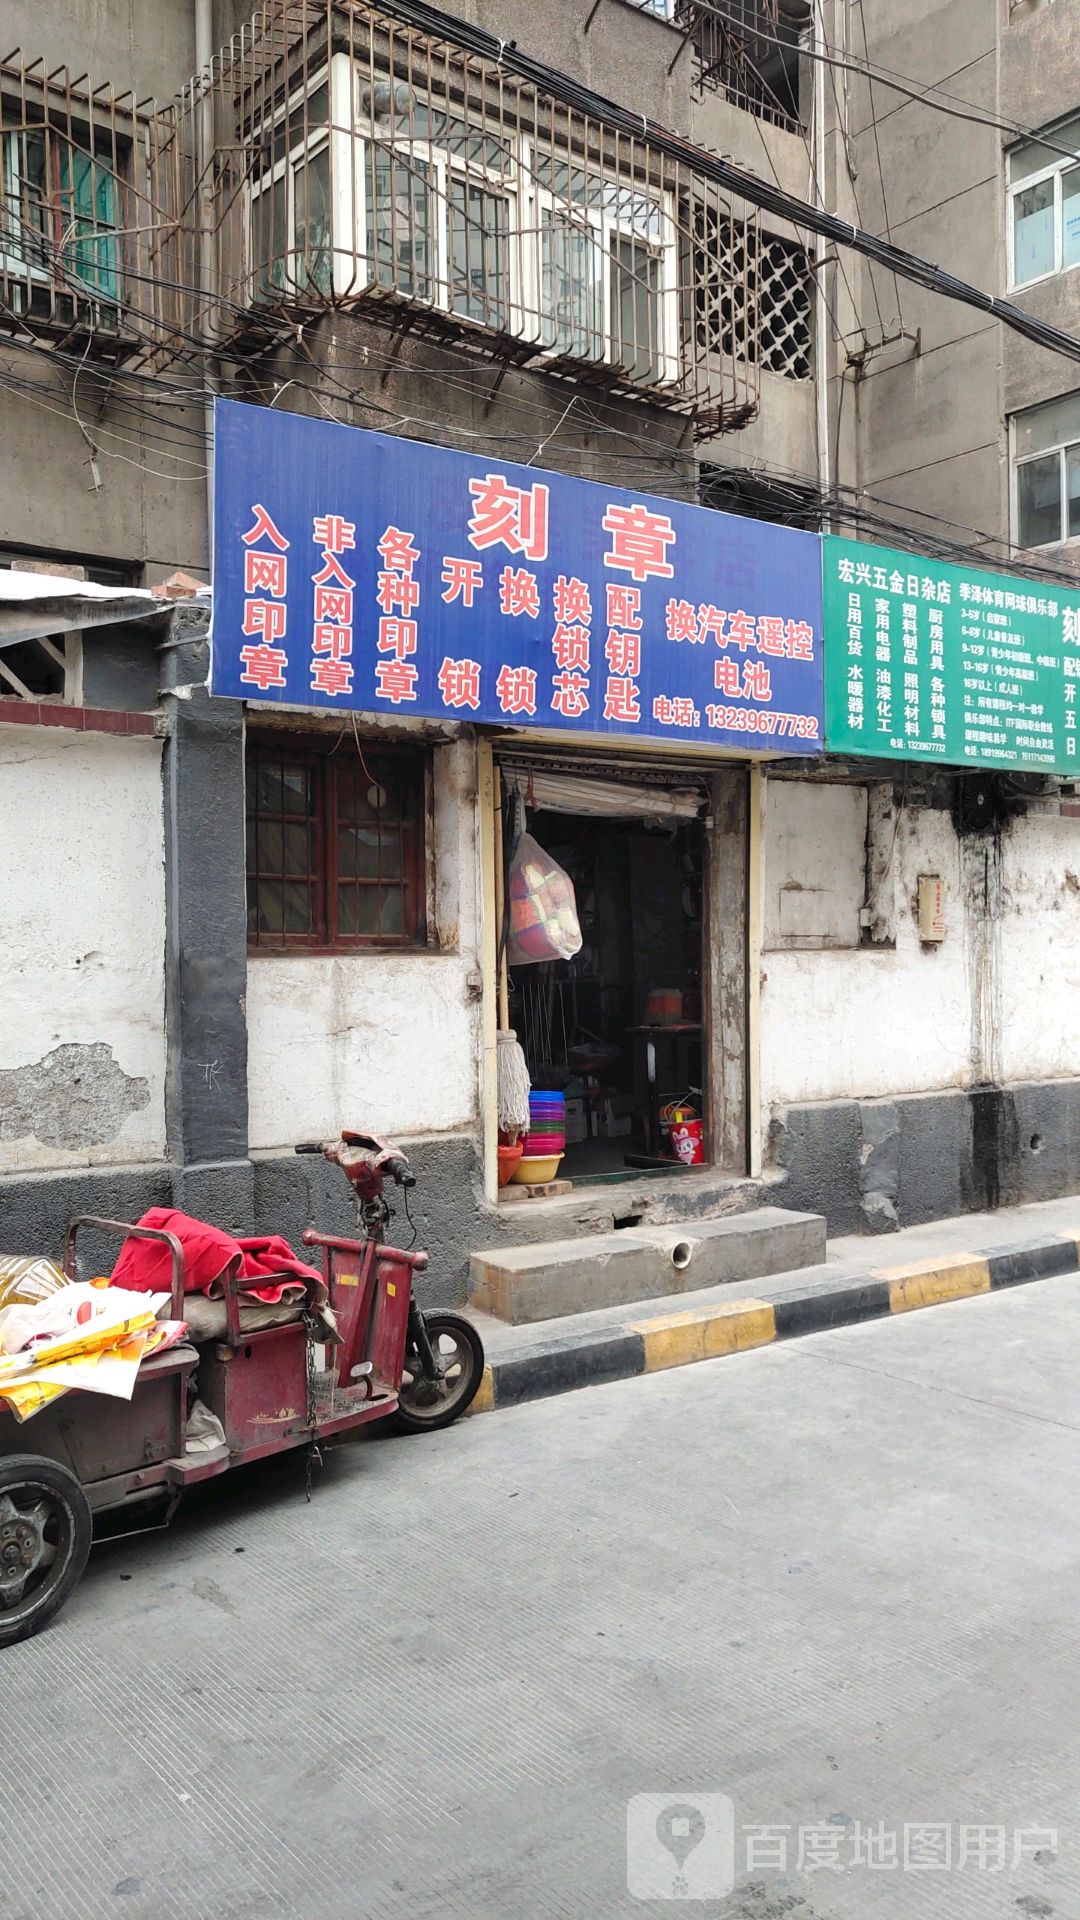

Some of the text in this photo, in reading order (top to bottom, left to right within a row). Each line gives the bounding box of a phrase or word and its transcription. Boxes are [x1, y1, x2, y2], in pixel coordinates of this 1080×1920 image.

[468, 474, 676, 582] 刻章
[838, 558, 951, 604] 宏兴五金日杂店
[241, 504, 290, 690] 入网印章
[310, 514, 355, 695] 非入网印章
[376, 526, 420, 703] 各种印章
[438, 556, 483, 710] 开锁
[496, 566, 540, 715] 换锁
[552, 575, 592, 717] 换锁芯
[604, 583, 643, 722] 配钥匙
[666, 598, 814, 660] 换汽车遥控
[847, 592, 864, 730] 日用百货 水暖器材
[959, 582, 1058, 618] 季泽体育网球俱乐部
[652, 695, 818, 739] 电话：13239677732
[714, 655, 772, 702] 电池
[875, 598, 892, 733] 家用电器 油漆化工
[902, 602, 920, 737] 塑料制品 照明材料
[928, 608, 946, 740] 厨房用具 各种锁具
[1064, 683, 1077, 703] 开
[1064, 710, 1077, 729] 五
[1066, 737, 1076, 755] 日
